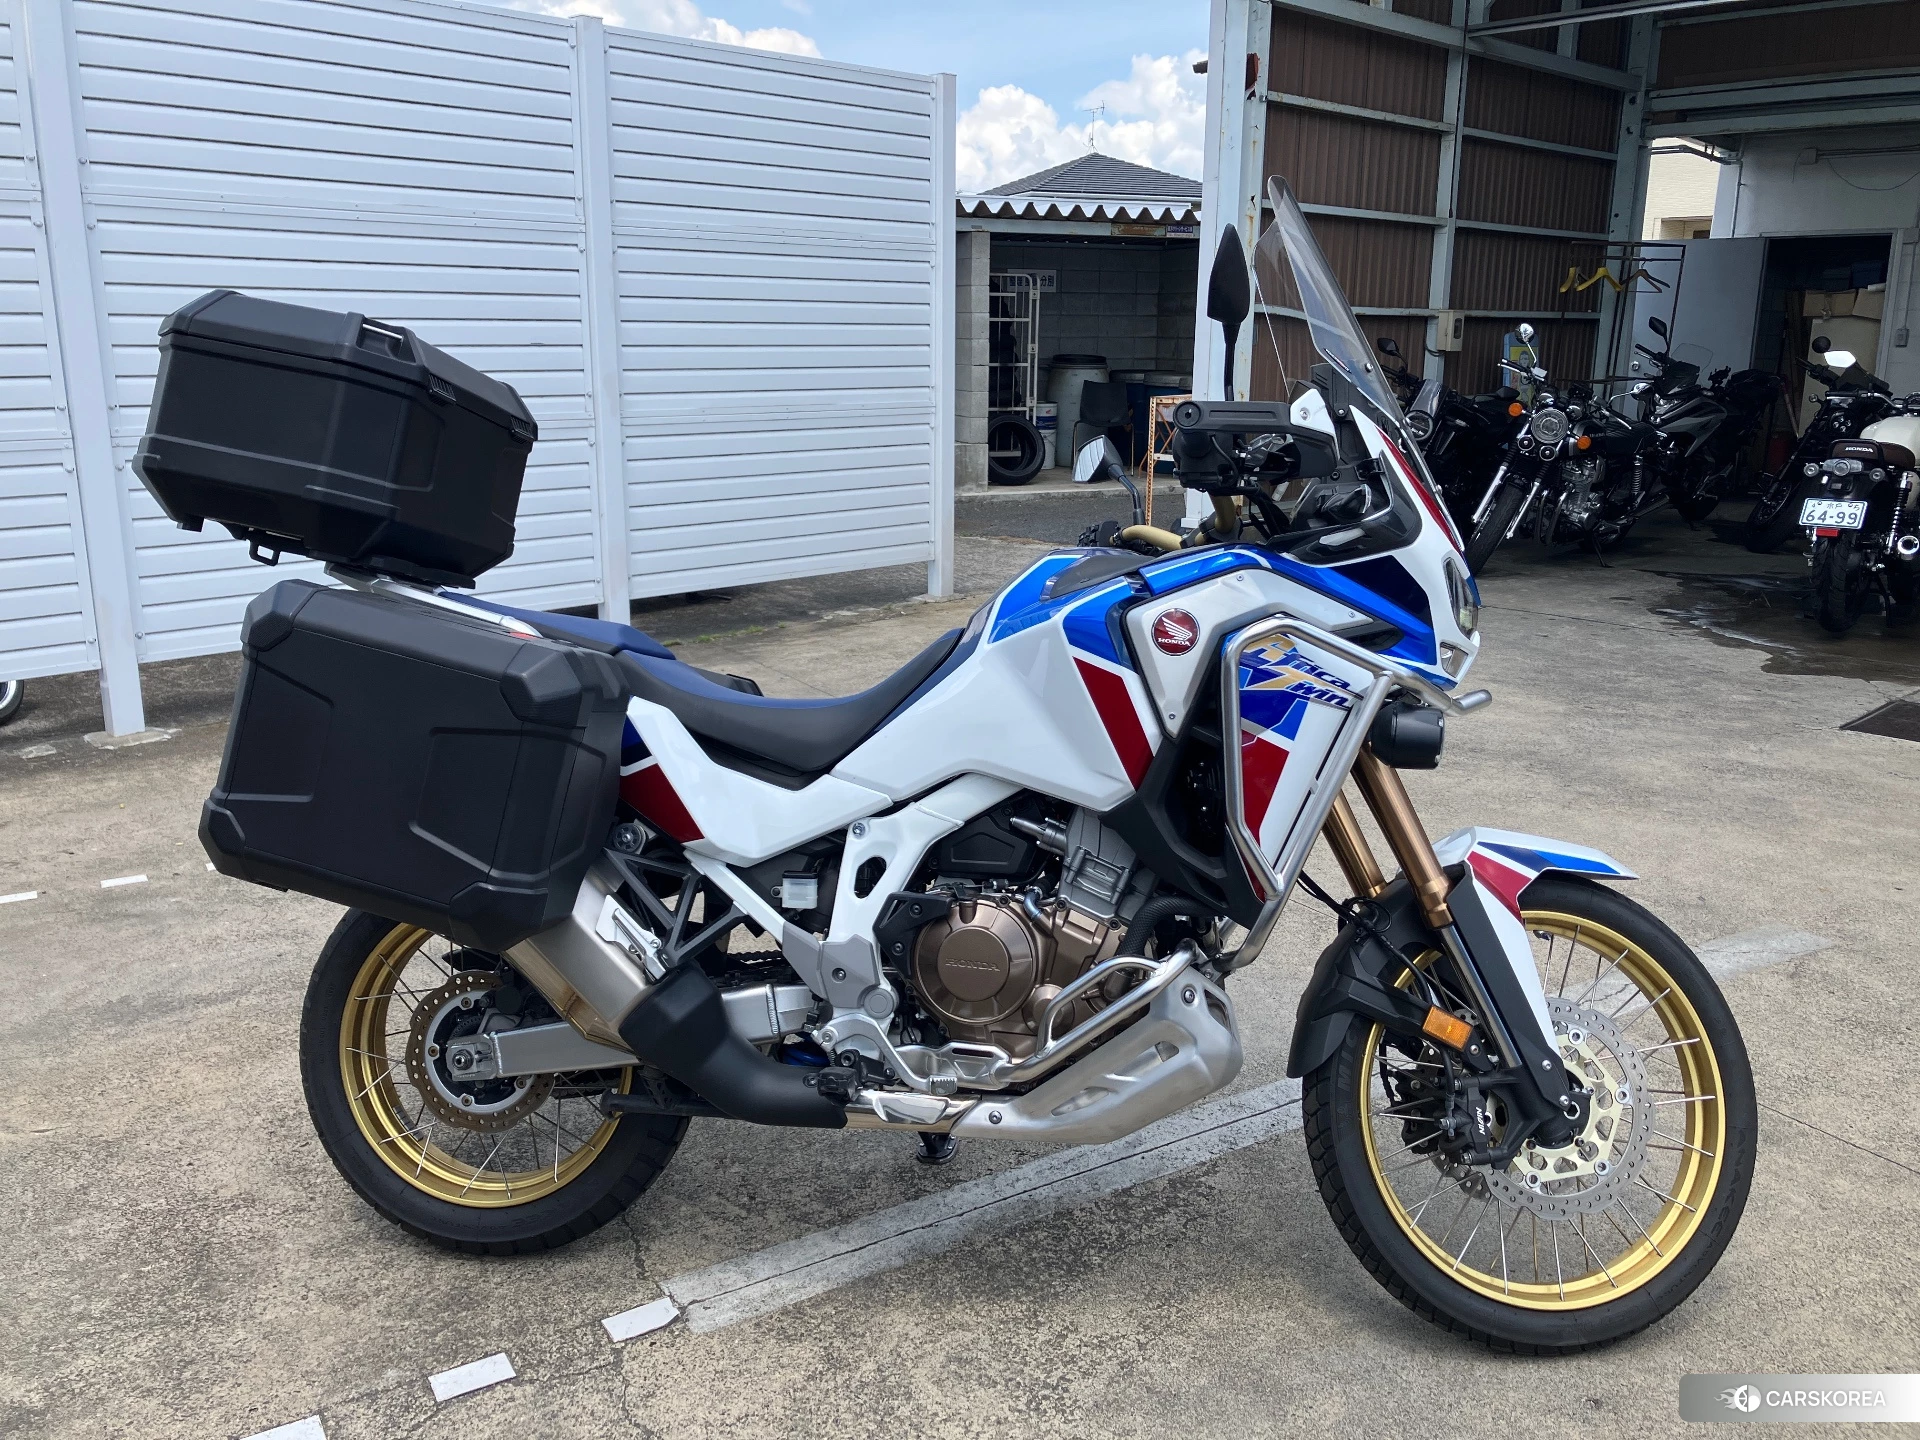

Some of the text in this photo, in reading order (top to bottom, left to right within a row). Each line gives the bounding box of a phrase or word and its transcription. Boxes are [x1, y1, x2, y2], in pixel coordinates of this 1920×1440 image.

[1805, 509, 1858, 525] 64-99
[1157, 637, 1191, 647] HONDA
[945, 957, 1001, 972] HONDA
